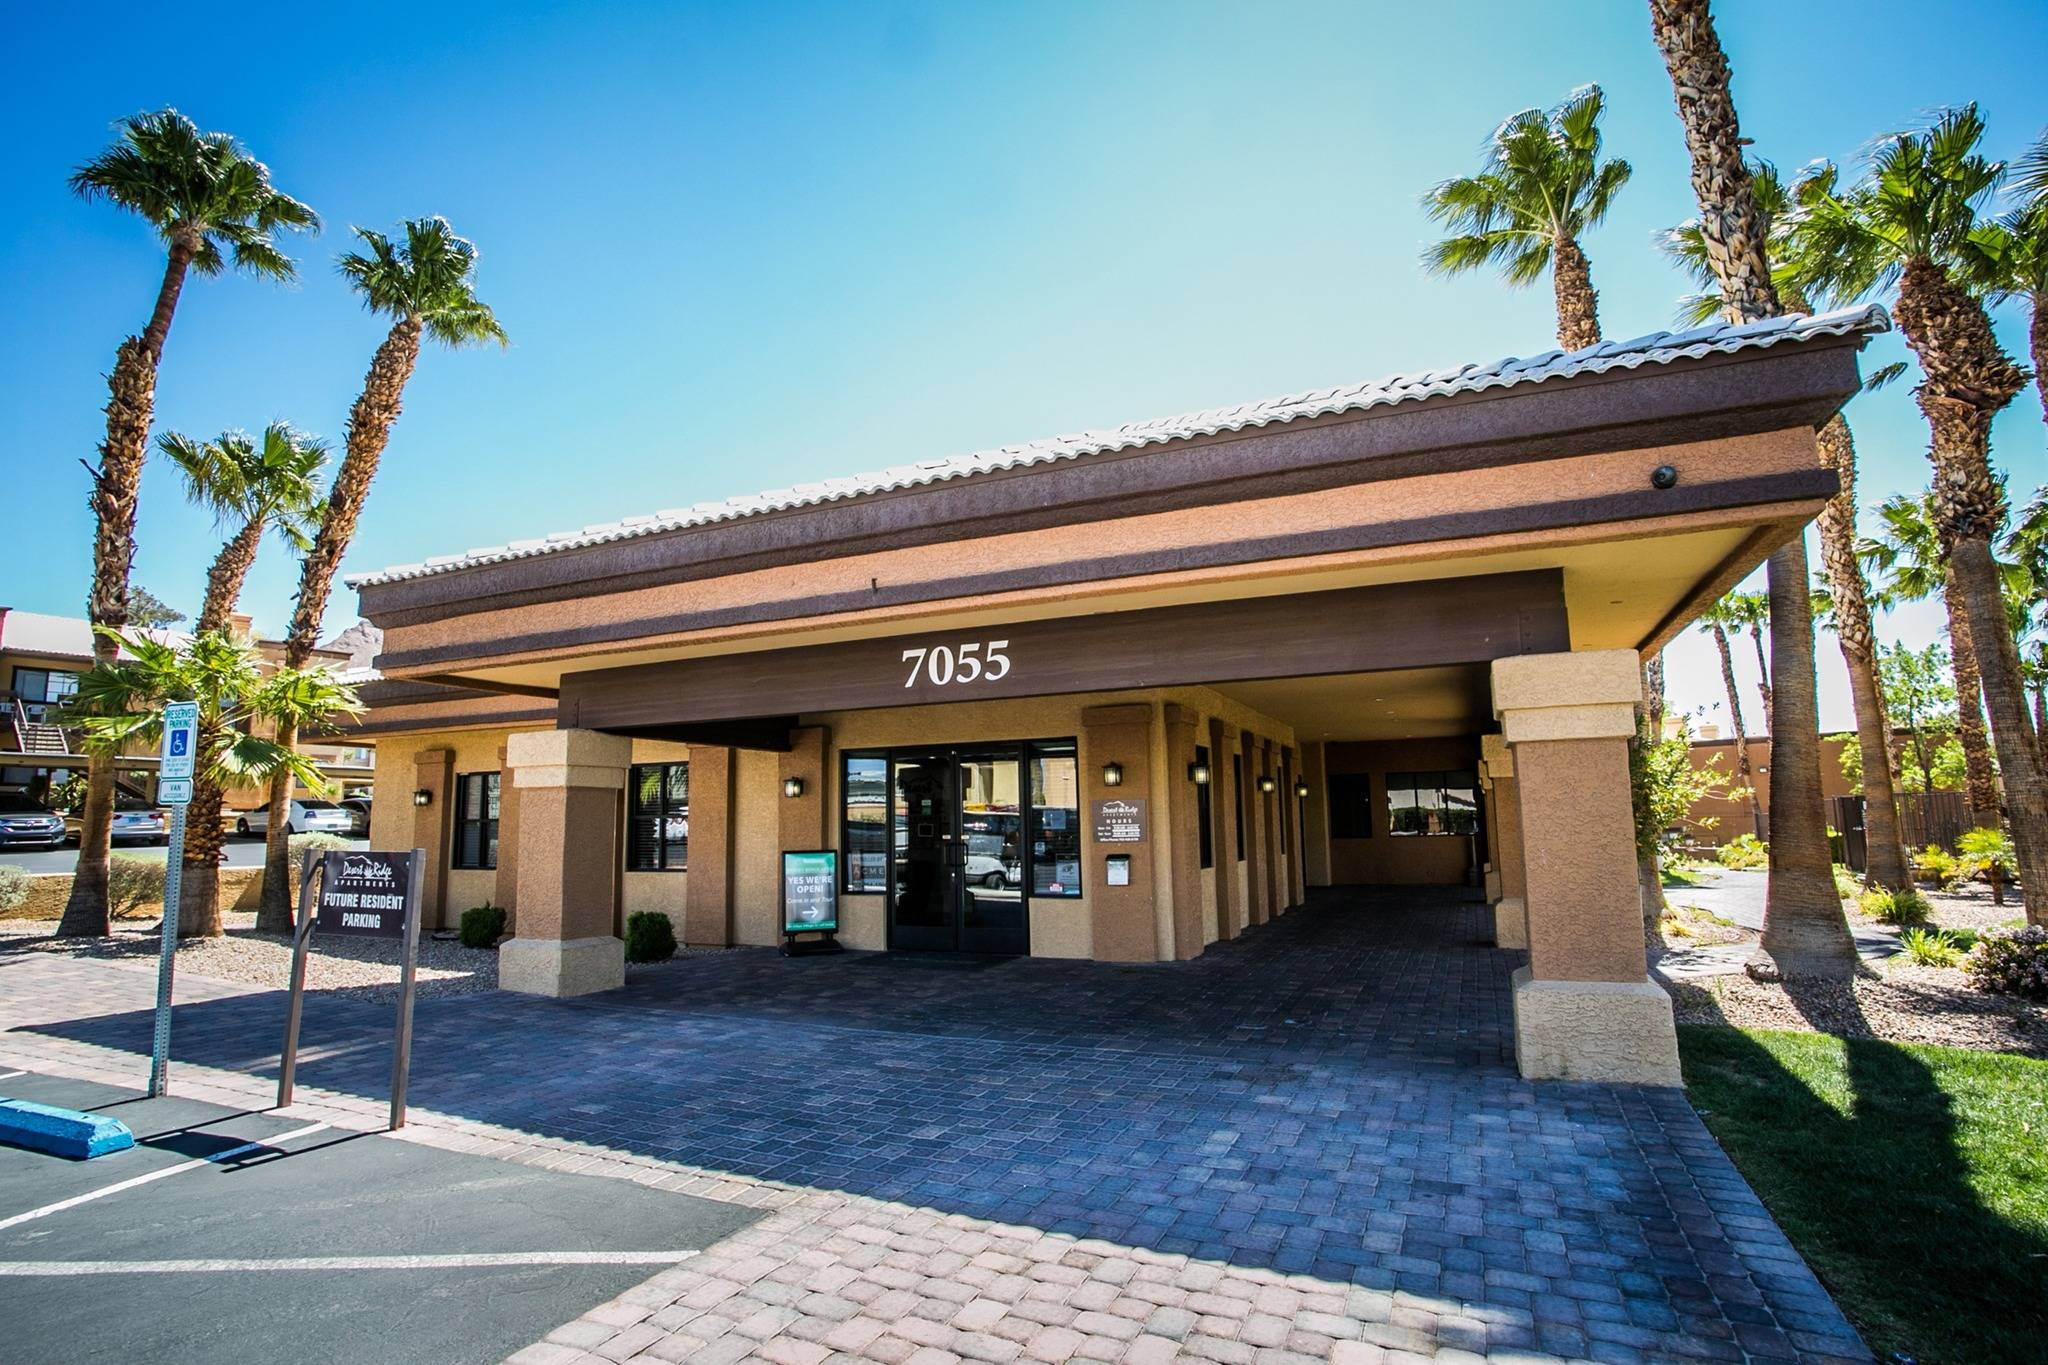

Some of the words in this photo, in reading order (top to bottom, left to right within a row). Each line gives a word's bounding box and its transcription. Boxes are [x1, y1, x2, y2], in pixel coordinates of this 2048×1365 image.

[902, 640, 1010, 688] 7055
[166, 709, 196, 719] RESERVED
[169, 719, 192, 728] PARKING
[342, 861, 364, 876] Desert
[373, 861, 392, 880] Ridge
[334, 879, 395, 888] APARTMENTS
[805, 875, 833, 884] WE'RE
[796, 885, 824, 893] OPEN!
[324, 892, 359, 908] FUTURE
[360, 893, 404, 910] RESIDENT
[342, 912, 381, 928] PARKING
